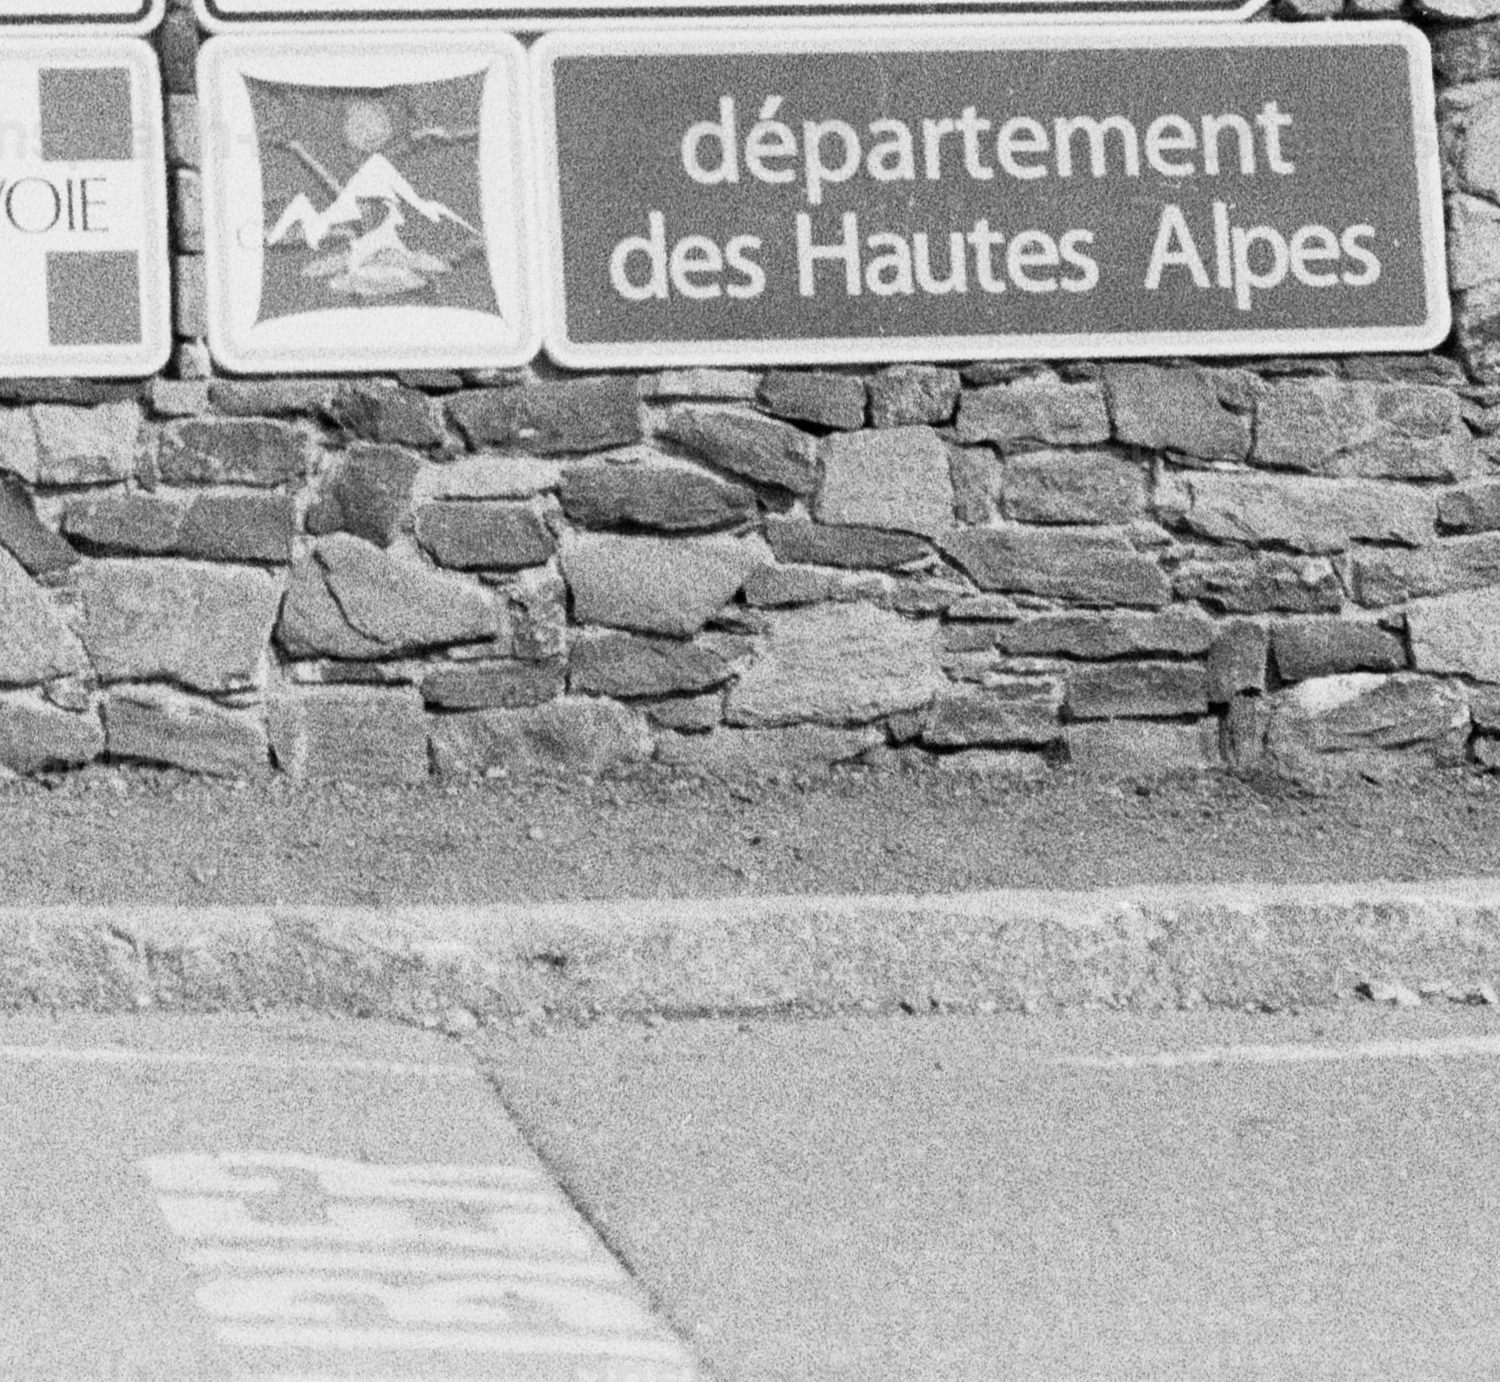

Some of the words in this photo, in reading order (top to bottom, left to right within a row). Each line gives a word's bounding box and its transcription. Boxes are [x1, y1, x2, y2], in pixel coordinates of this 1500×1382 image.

[679, 93, 1297, 204] département
[607, 208, 768, 303] des
[793, 209, 1102, 299] Hautes
[1142, 198, 1384, 313] Alpes
